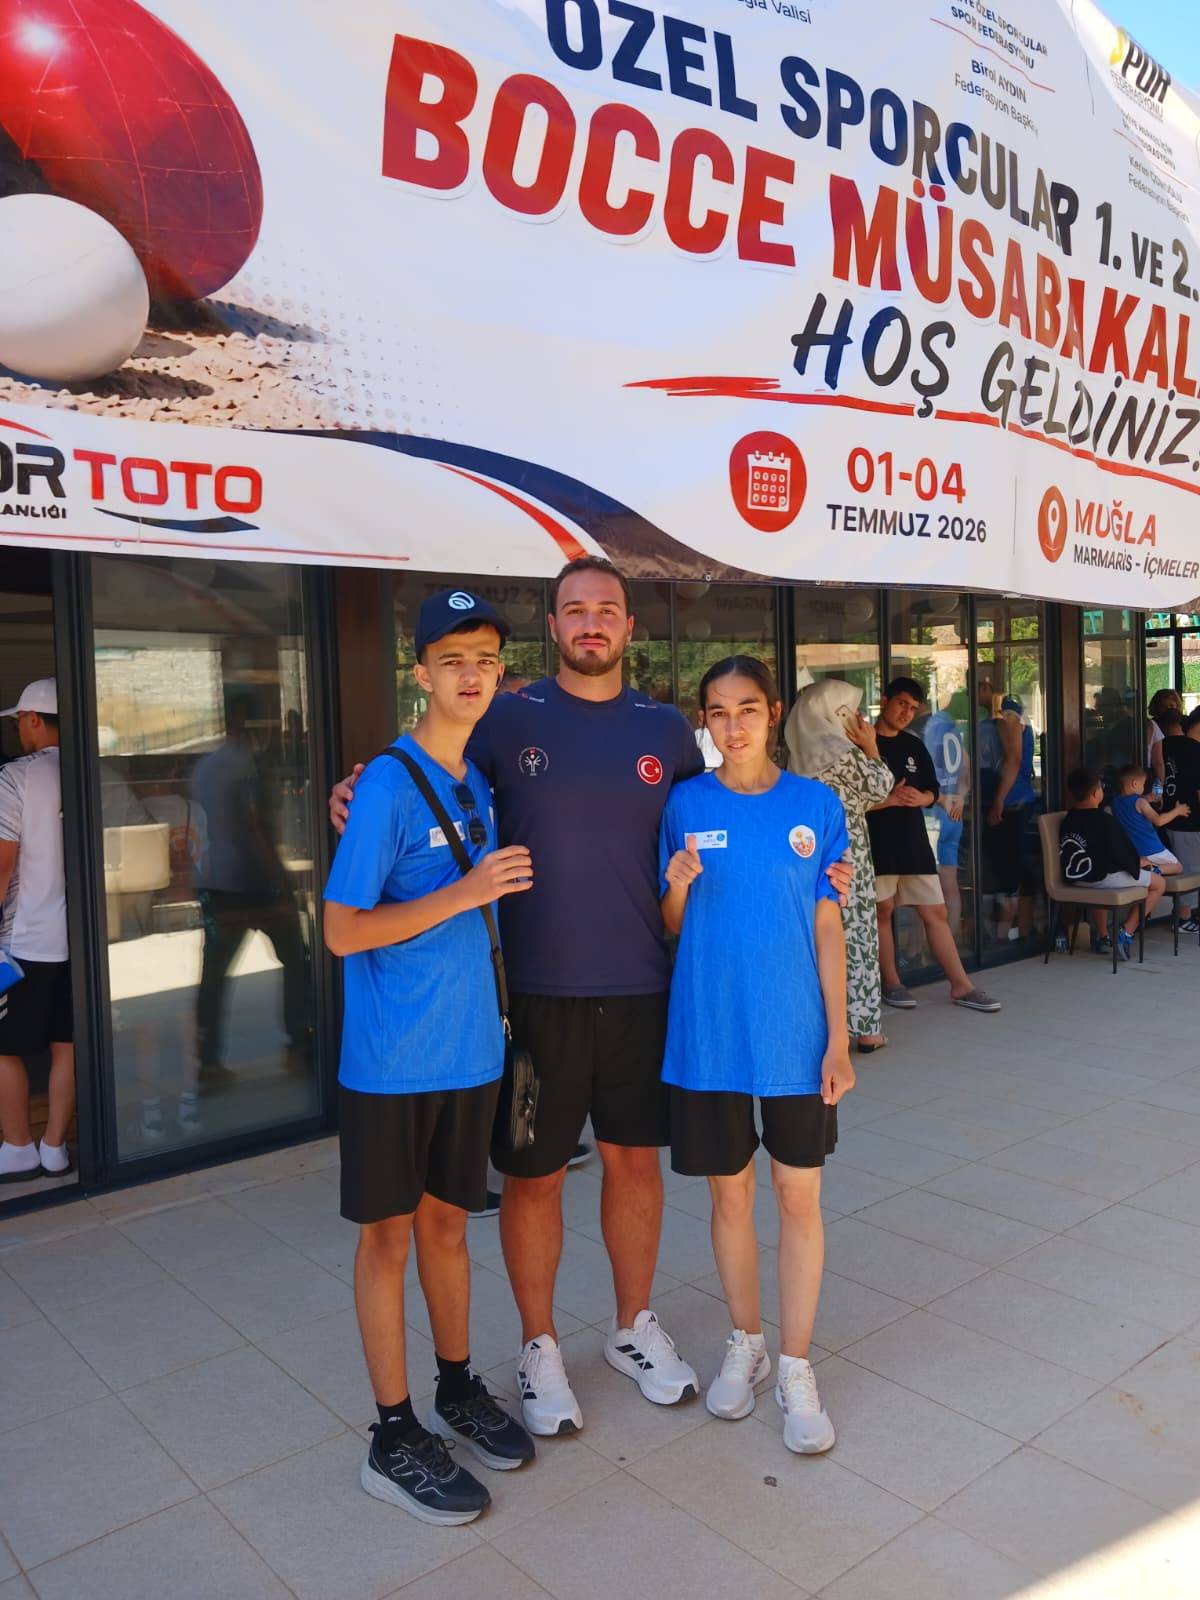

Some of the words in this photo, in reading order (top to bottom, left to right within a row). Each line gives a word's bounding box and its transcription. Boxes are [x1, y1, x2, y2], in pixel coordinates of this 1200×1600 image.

[771, 0, 812, 24] Valisi
[951, 6, 977, 29] SPOR
[955, 73, 1010, 115] Federasyon
[971, 59, 996, 83] Birol
[998, 74, 1027, 103] AYDIN
[780, 56, 1079, 256] SPORCULAR
[1095, 201, 1122, 270] 1.
[1131, 231, 1163, 288] VE
[1172, 238, 1199, 302] 2.
[382, 33, 796, 267] BOCCE
[829, 173, 1200, 400] MÜSABAKAL
[790, 292, 956, 418] HOŞ
[73, 448, 263, 514] TOTO
[847, 446, 966, 504] 01-04
[0, 503, 67, 519] ANLIĞI
[826, 504, 931, 538] TEMMUZ
[937, 515, 987, 543] 2026
[1074, 498, 1157, 547] MUĞLA
[1073, 543, 1133, 572] MARMARİS
[1143, 551, 1200, 580] İÇMELER
